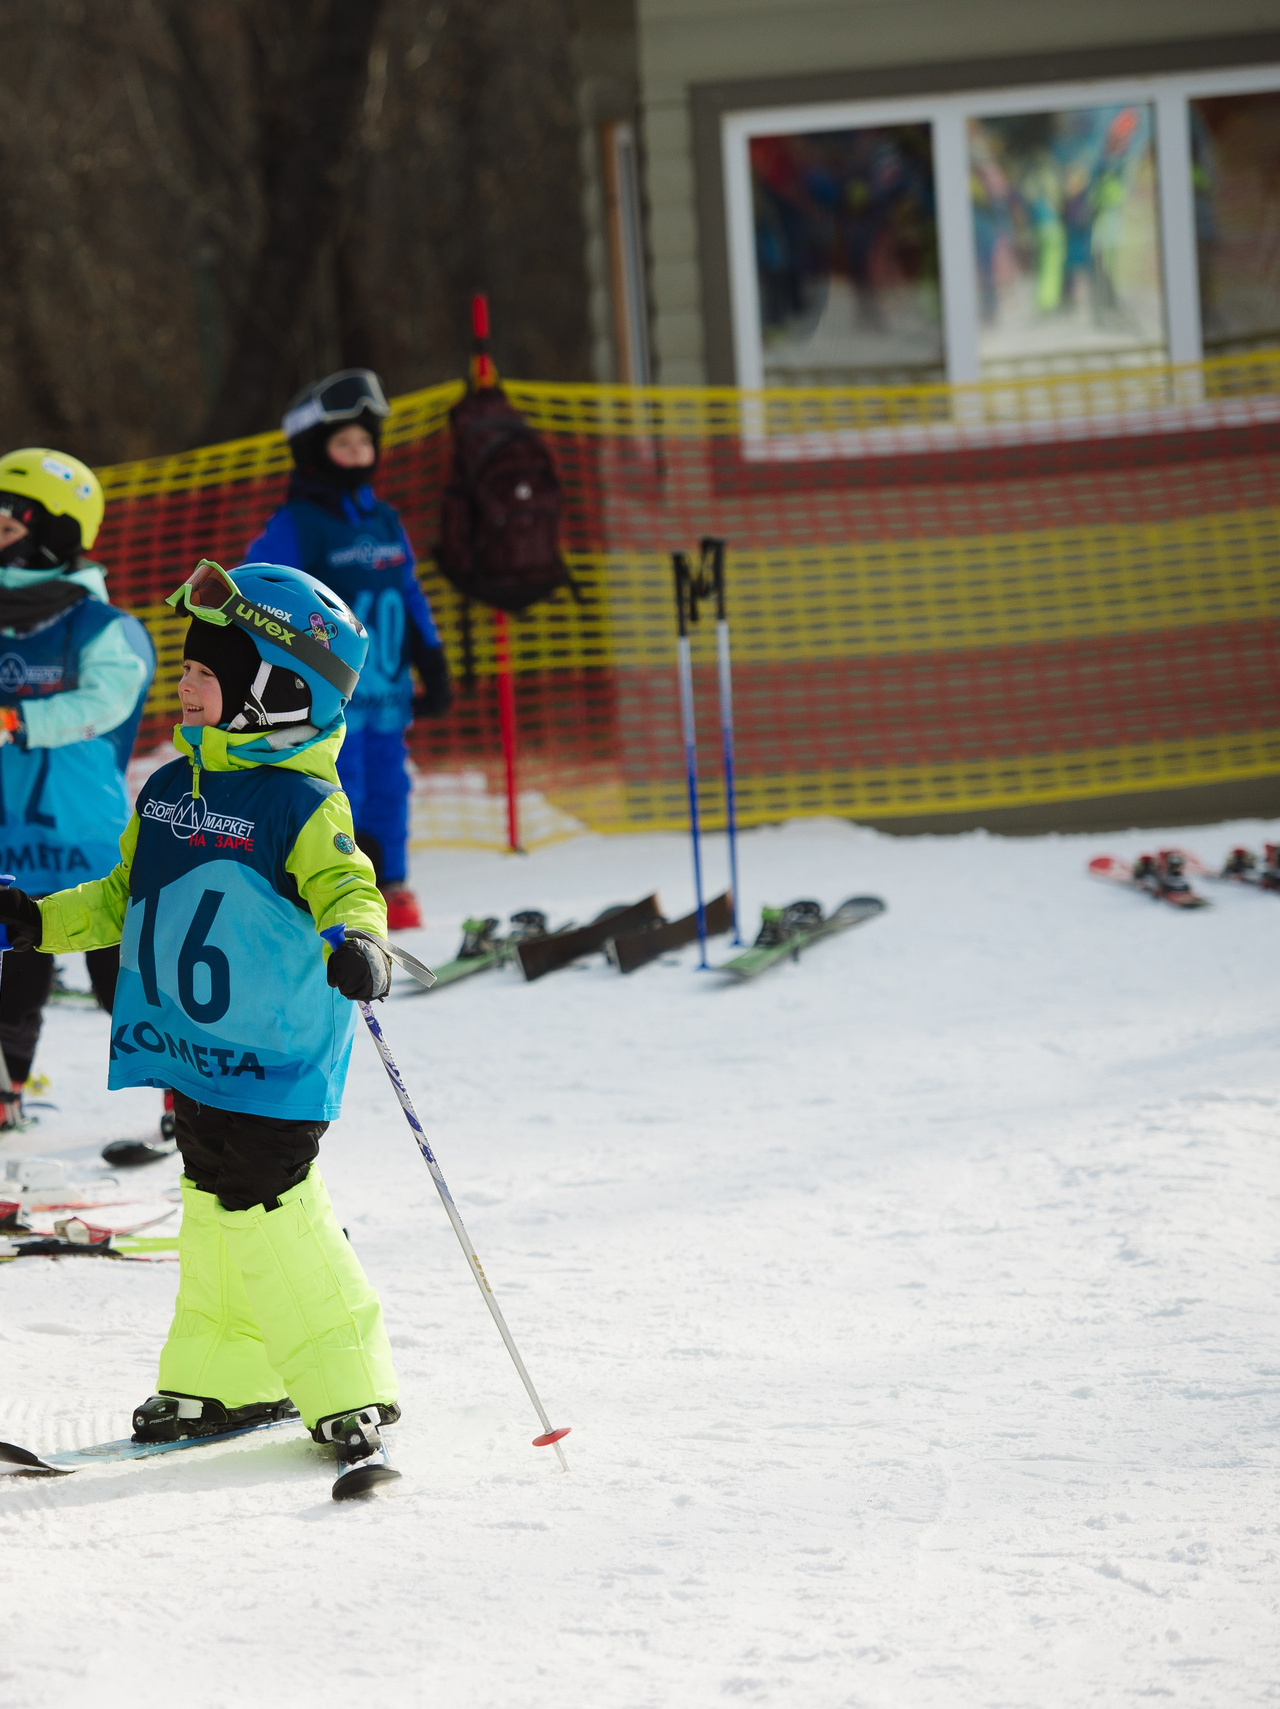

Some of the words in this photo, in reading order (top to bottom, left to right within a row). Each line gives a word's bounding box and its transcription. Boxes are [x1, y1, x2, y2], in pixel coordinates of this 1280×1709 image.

[235, 603, 296, 646] uvex
[188, 833, 206, 847] НА
[214, 835, 255, 852] ЗАРЕ
[204, 815, 255, 838] МАРКЕТ
[131, 882, 231, 1025] 16
[110, 1021, 266, 1081] КОМЕТА
[149, 1414, 175, 1425] FISCHER
